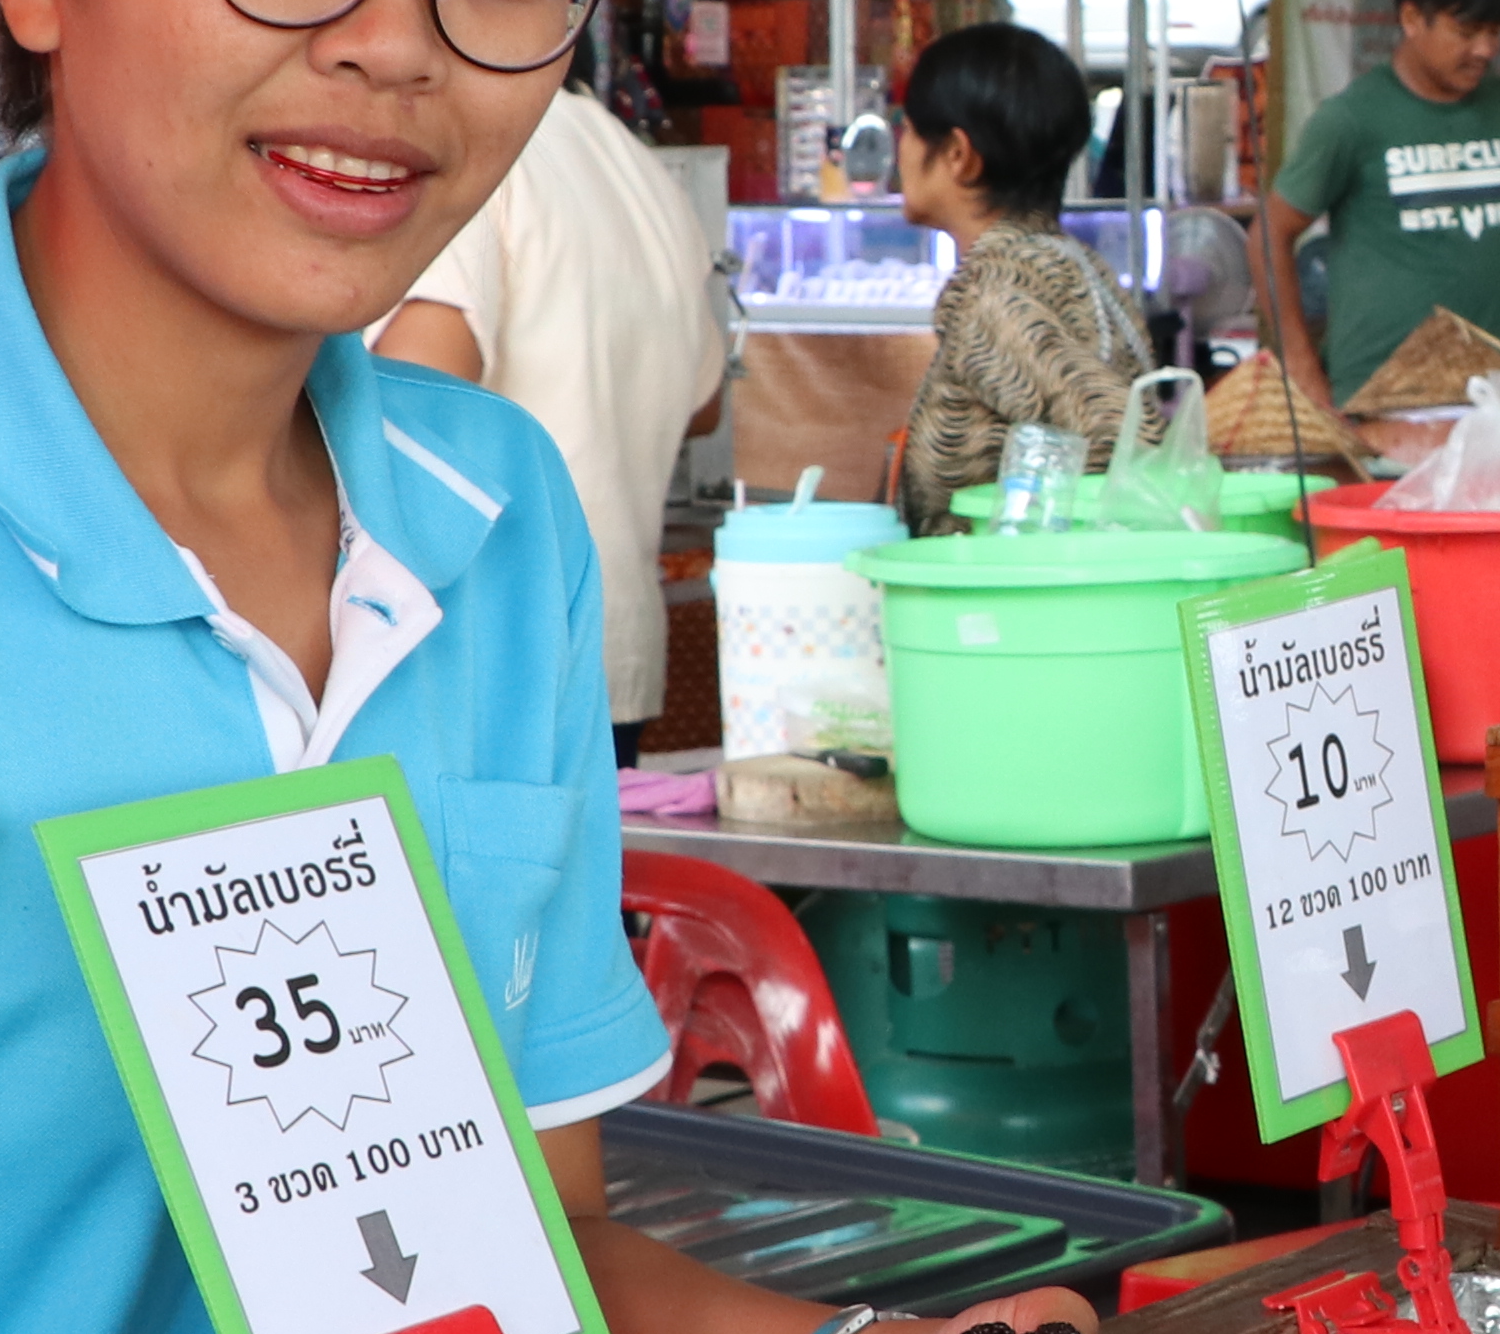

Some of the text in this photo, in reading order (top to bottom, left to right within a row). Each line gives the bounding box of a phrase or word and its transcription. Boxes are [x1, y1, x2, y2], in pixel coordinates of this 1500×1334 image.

[1240, 606, 1386, 700] น้ำมัลเบอร์รี่
[1288, 733, 1378, 811] 10 บาท
[137, 818, 379, 937] น้ำมัลเบอร์รี่
[1266, 849, 1432, 929] 12 ขวด 100 บาท
[234, 972, 387, 1069] 35 บาท
[236, 1117, 485, 1215] 3 ขวด 100 บาท
